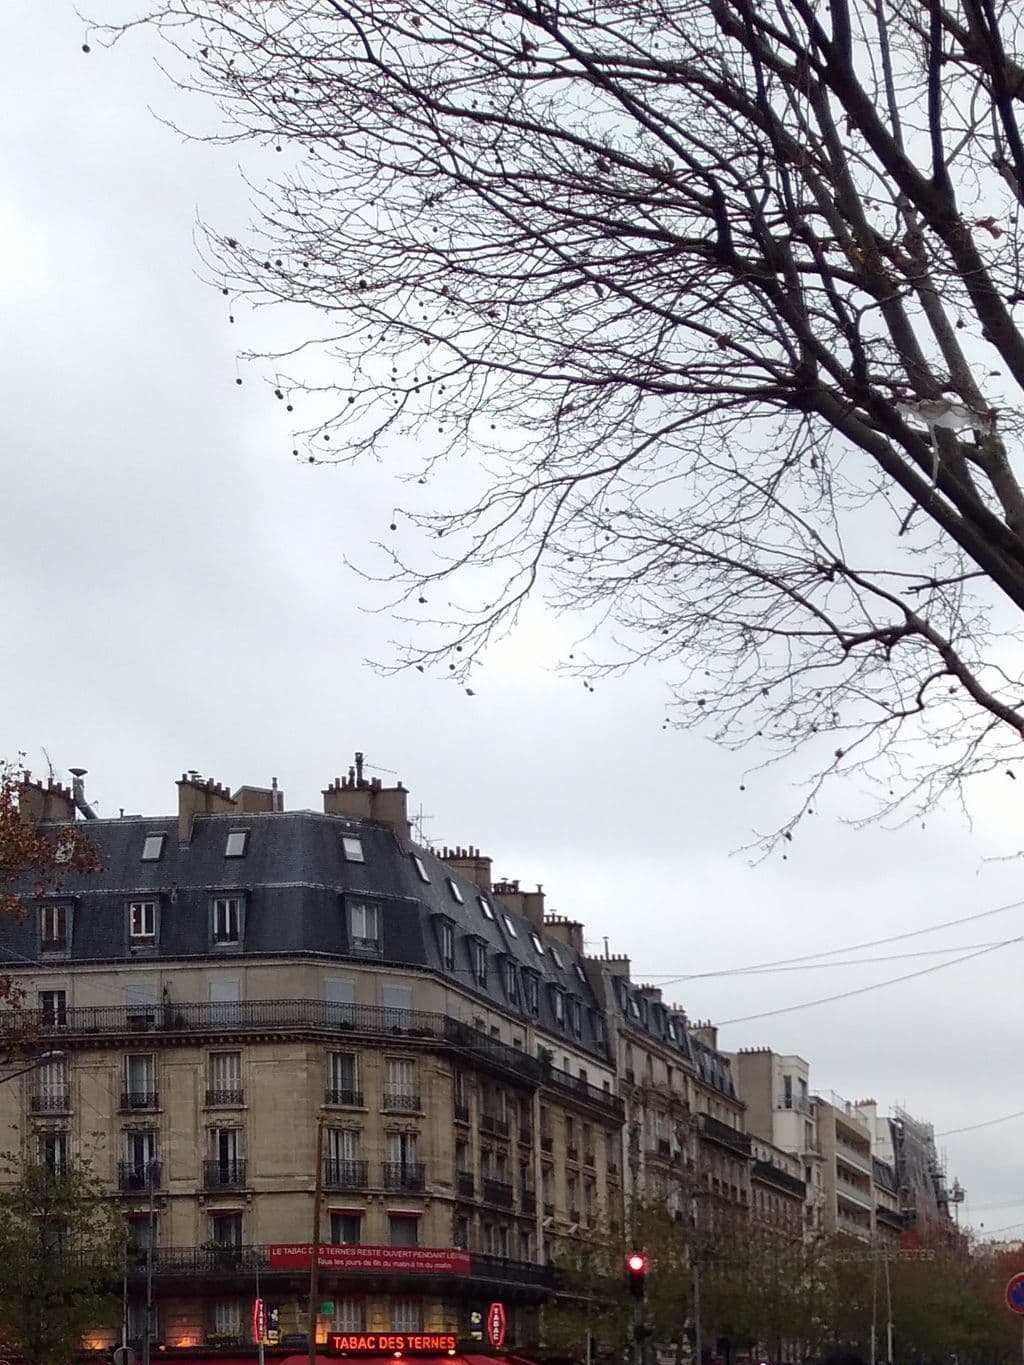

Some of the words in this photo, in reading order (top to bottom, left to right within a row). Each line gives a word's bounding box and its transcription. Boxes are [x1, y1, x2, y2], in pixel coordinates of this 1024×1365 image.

[272, 1247, 281, 1255] LE
[283, 1247, 307, 1255] TABAC
[308, 1247, 324, 1255] DS
[326, 1248, 355, 1256] TERNES
[357, 1248, 381, 1257] RESTE
[413, 1250, 446, 1259] PENDANT
[345, 1258, 362, 1267] jours
[333, 1336, 375, 1349] TABAC
[379, 1336, 404, 1349] DES
[406, 1336, 455, 1349] TERNES
